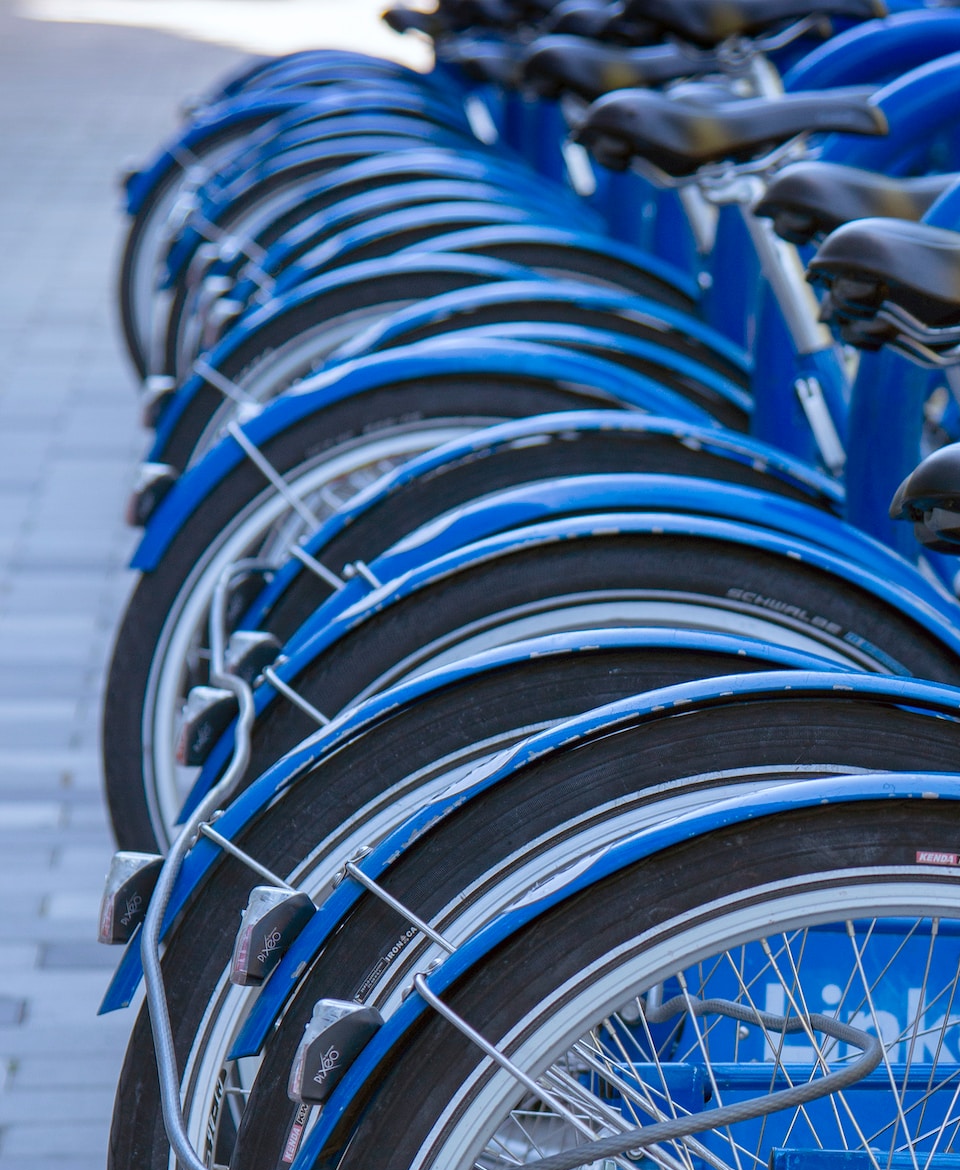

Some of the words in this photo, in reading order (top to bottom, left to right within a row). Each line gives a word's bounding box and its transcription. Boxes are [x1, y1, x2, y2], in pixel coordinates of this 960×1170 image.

[918, 852, 956, 864] KENDA
[384, 940, 404, 962] IRON
[284, 1127, 301, 1161] KENDA
